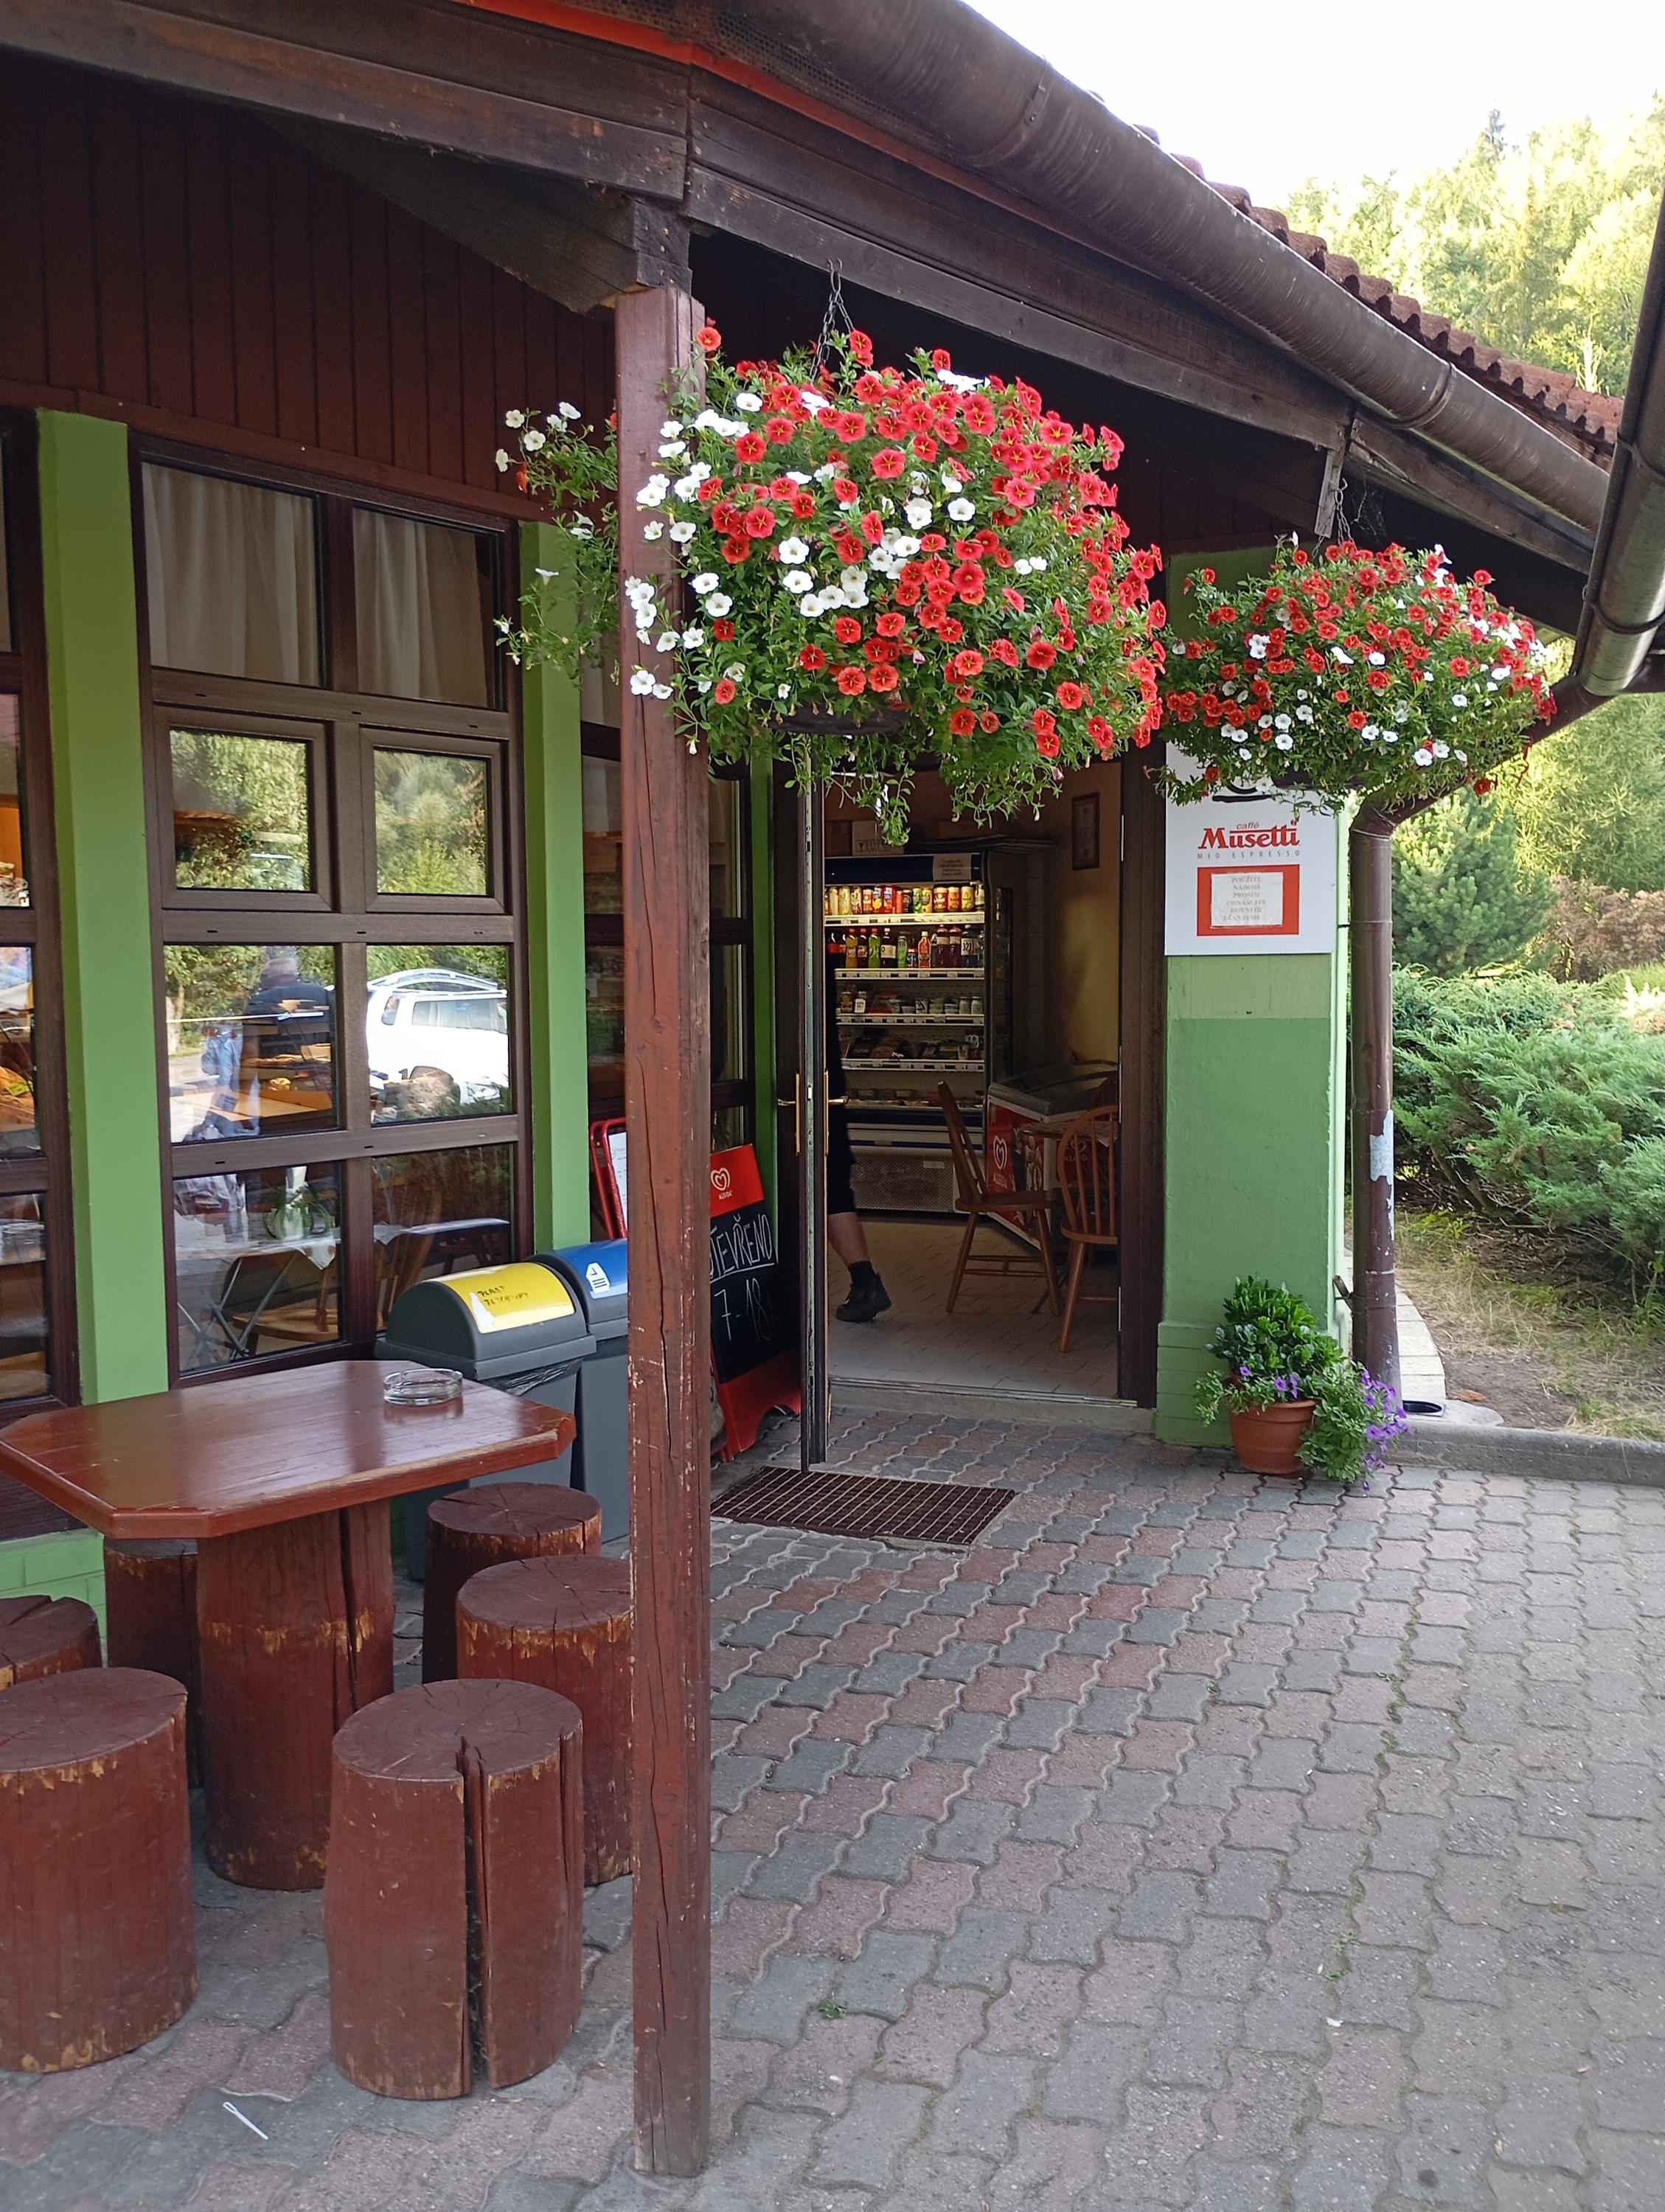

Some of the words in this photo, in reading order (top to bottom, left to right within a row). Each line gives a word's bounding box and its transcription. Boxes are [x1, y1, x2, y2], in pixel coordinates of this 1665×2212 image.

[1198, 819, 1301, 849] Musetti
[1198, 852, 1220, 860] MIO
[1232, 849, 1300, 859] ESPRESSO
